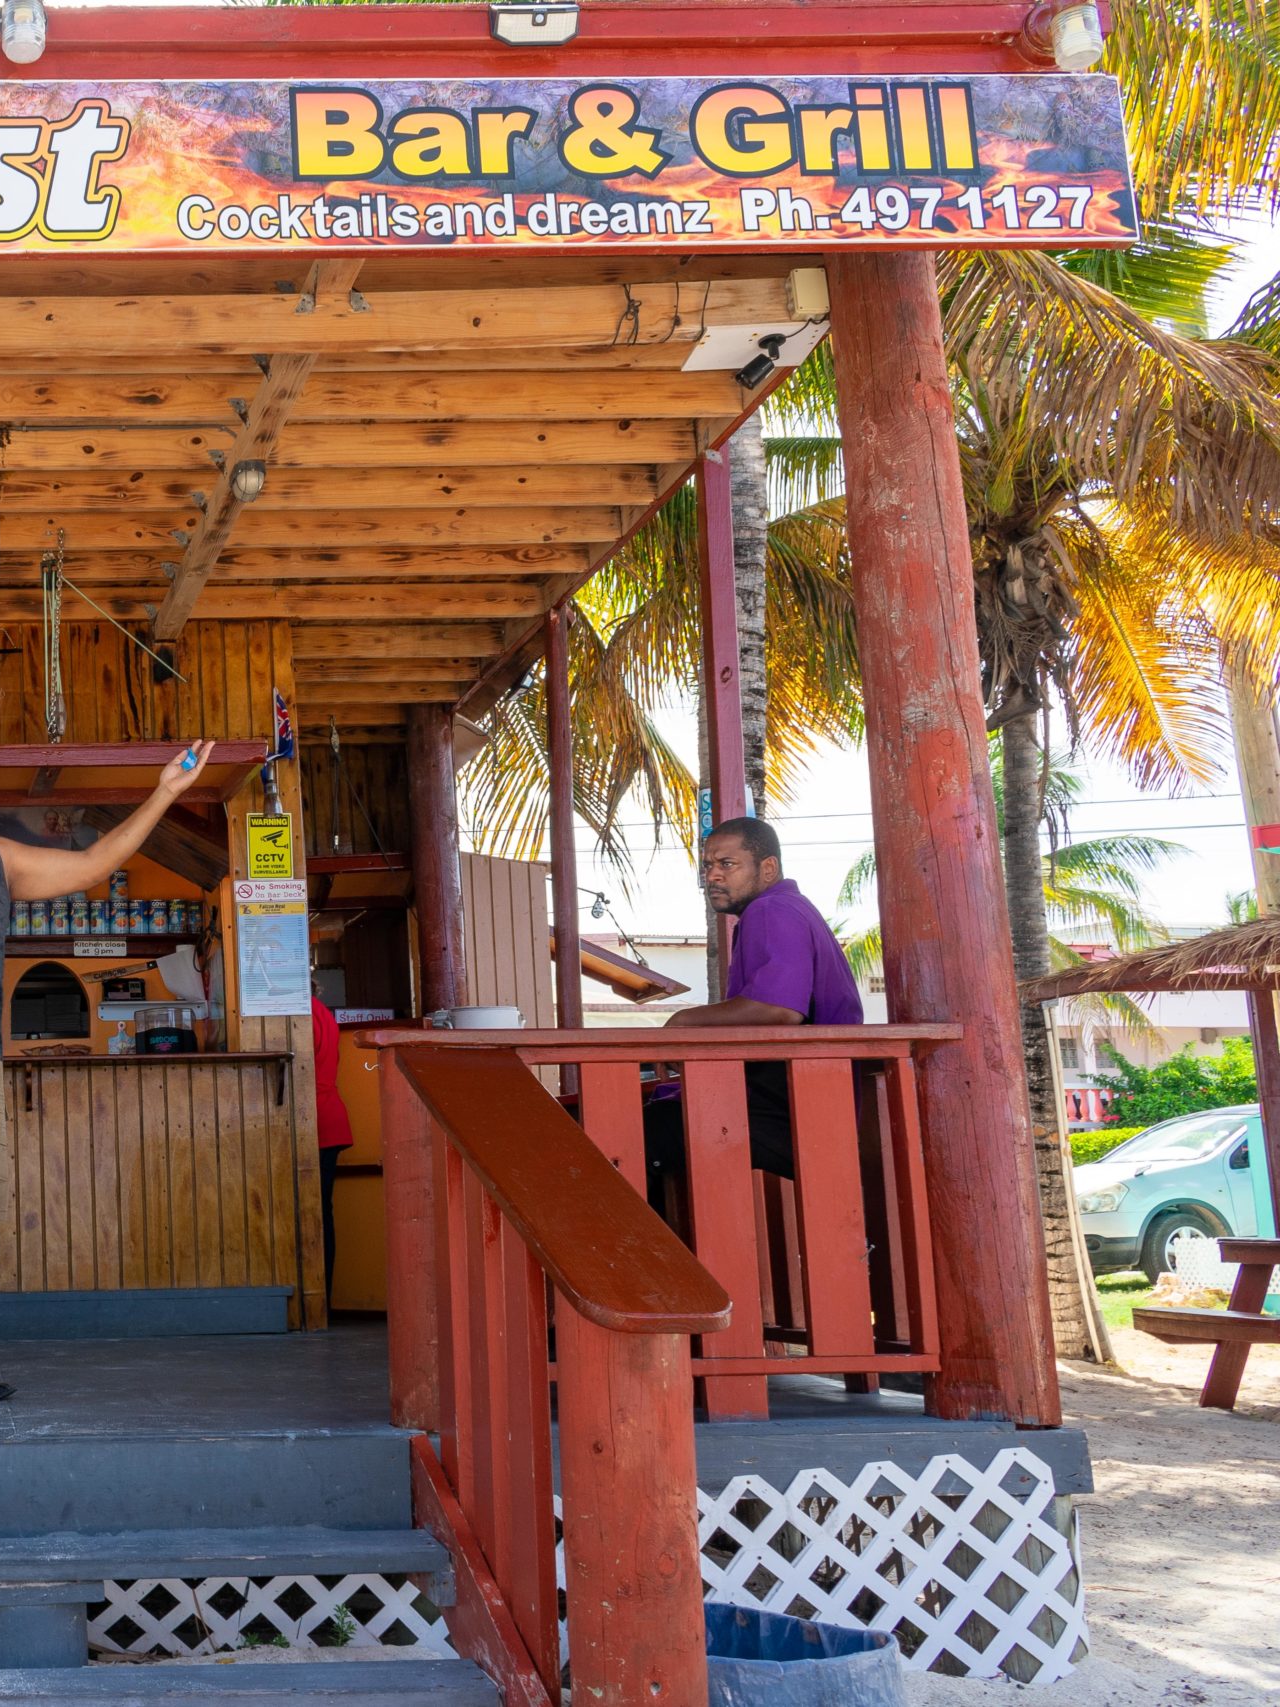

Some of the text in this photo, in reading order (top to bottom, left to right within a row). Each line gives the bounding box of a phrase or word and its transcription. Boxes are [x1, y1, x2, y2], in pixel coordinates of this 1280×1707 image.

[289, 82, 980, 182] Bar & Grill
[526, 193, 713, 235] dreamz
[738, 187, 830, 231] Ph.
[840, 187, 943, 230] 497
[957, 184, 1093, 230] 1127
[251, 818, 288, 826] WARNING
[255, 853, 285, 862] CCTV
[269, 883, 302, 891] Smoking
[339, 1013, 363, 1023] Staff
